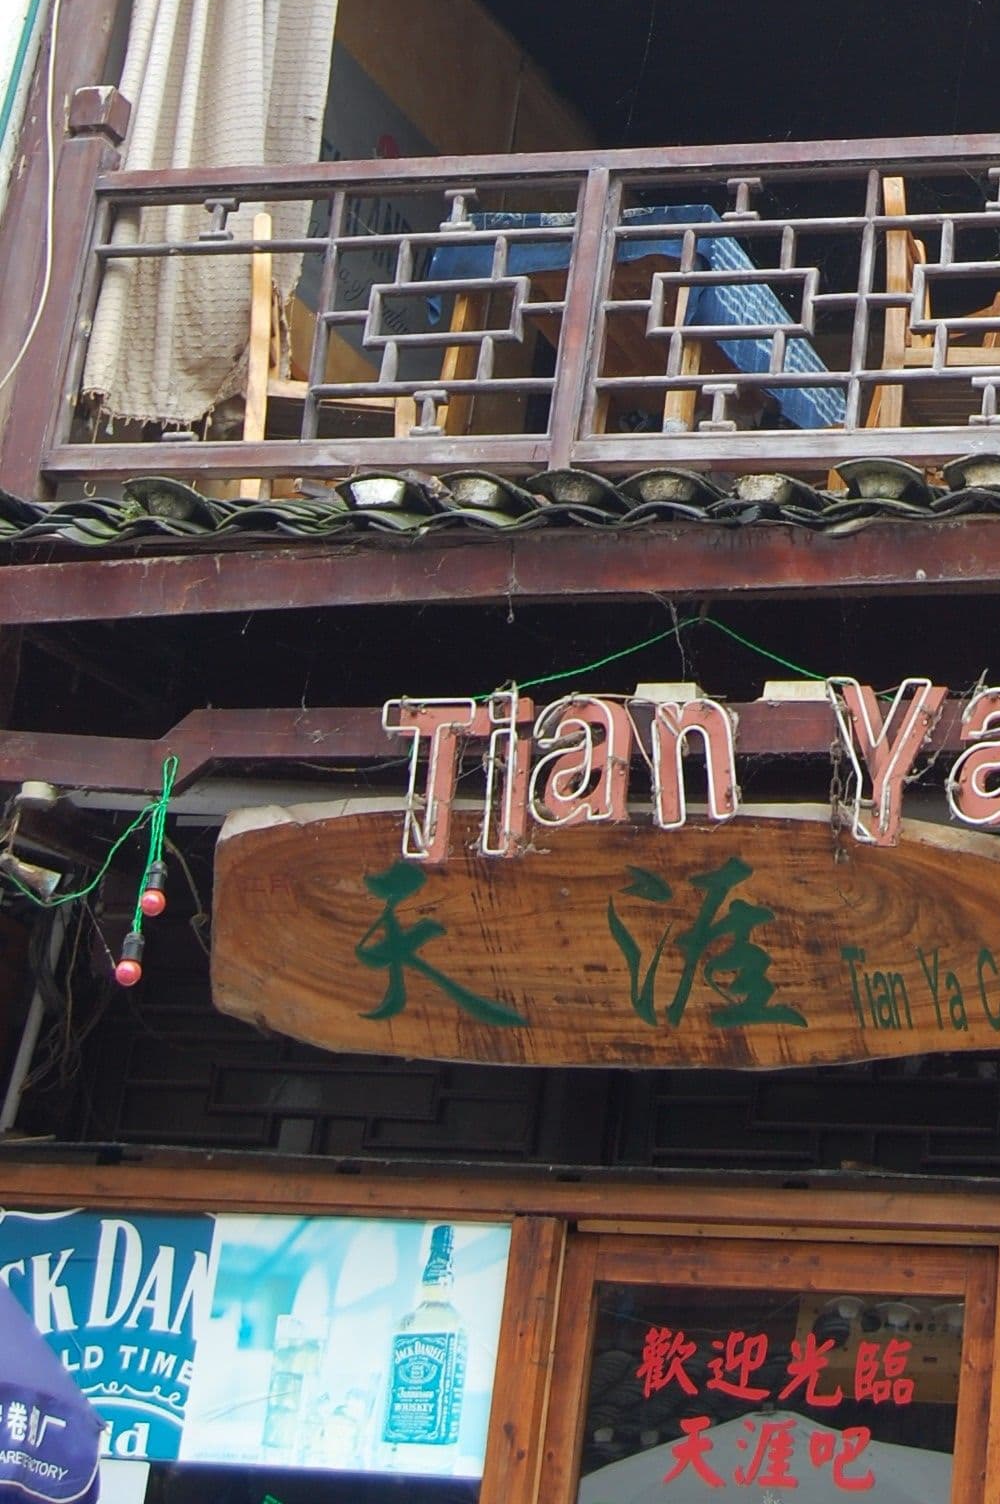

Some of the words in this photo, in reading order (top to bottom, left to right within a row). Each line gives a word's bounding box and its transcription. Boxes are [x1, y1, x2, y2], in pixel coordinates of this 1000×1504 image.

[382, 688, 739, 863] Tian
[355, 856, 808, 1029] 天涯
[841, 945, 913, 1031] Tian
[916, 946, 968, 1032] Ya
[62, 1345, 104, 1372] LD
[637, 1327, 913, 1406] 歡迎光臨
[663, 1415, 875, 1492] 天涯吧
